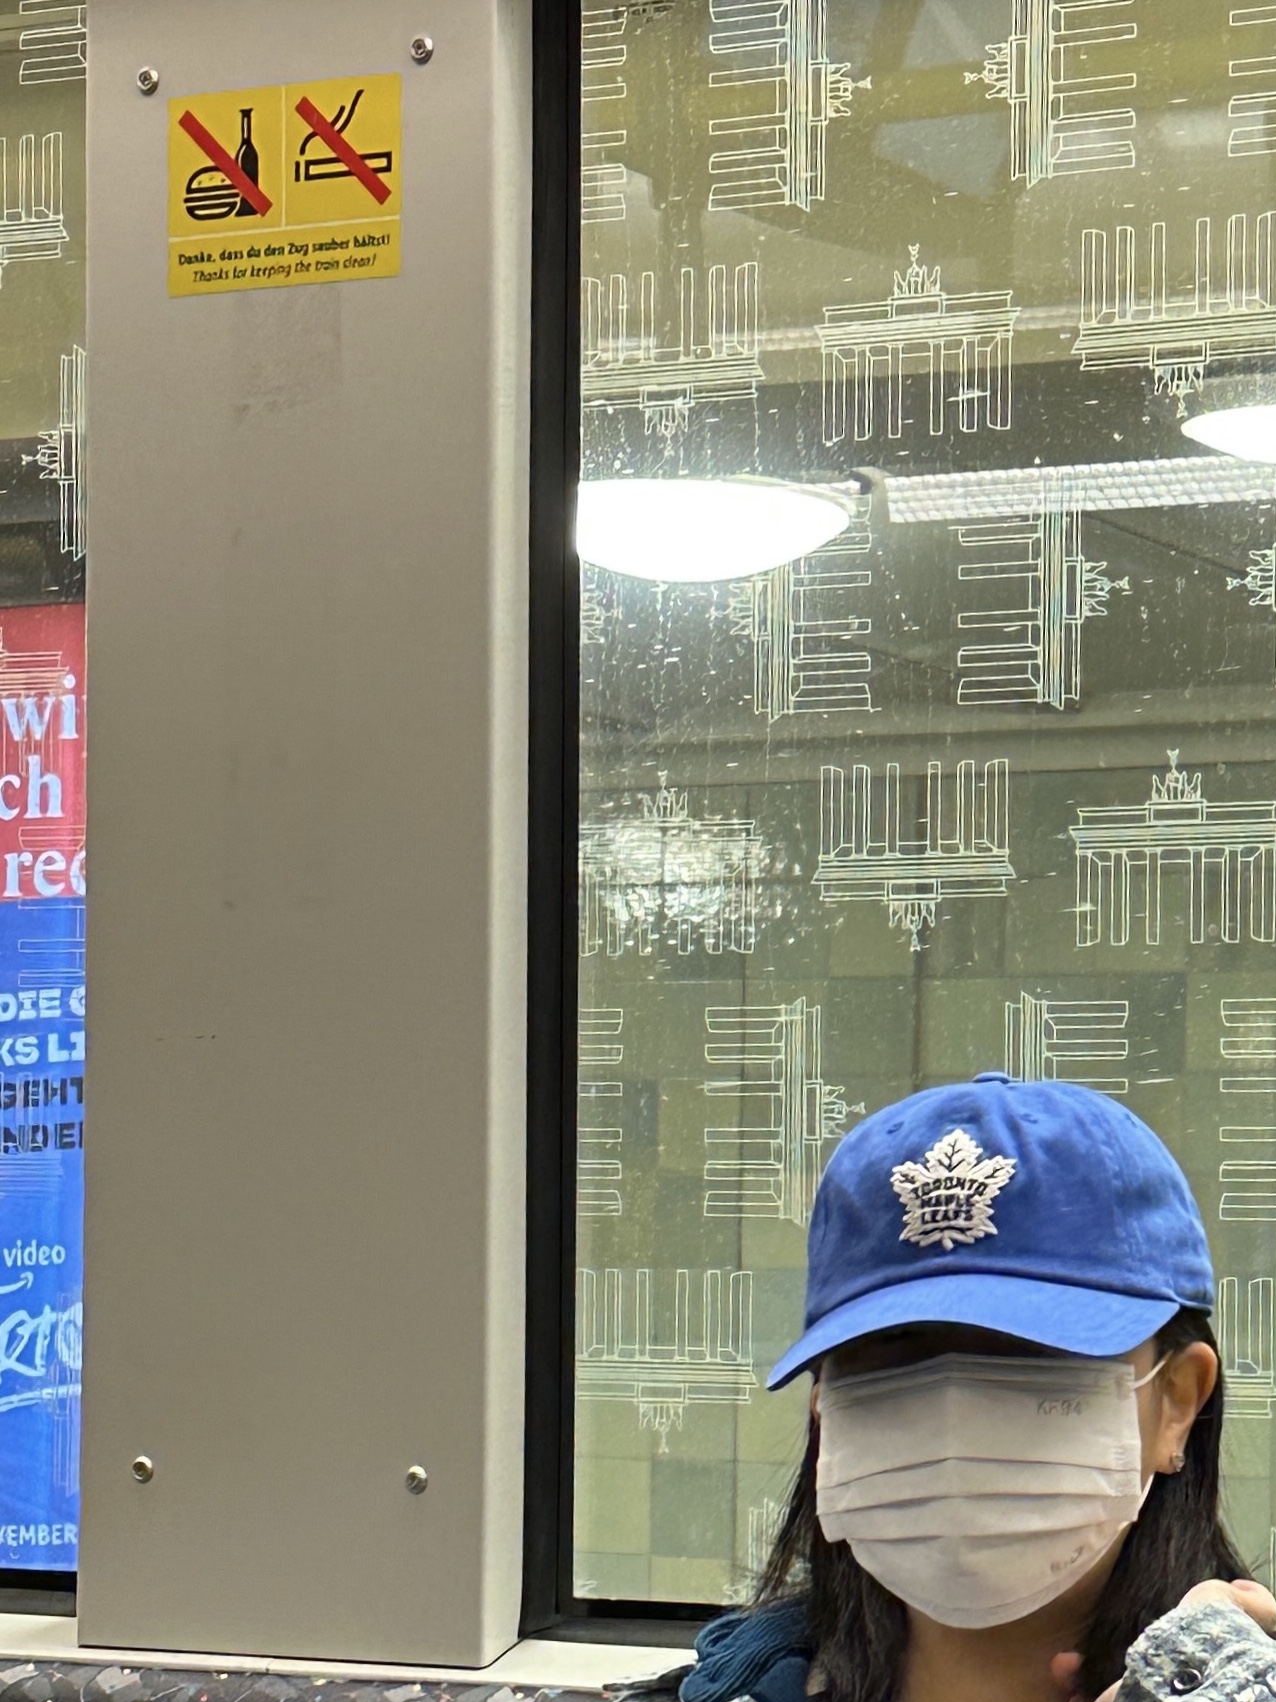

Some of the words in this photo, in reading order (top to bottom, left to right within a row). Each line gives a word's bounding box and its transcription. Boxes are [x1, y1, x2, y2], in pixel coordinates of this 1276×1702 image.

[219, 249, 244, 261] dass
[246, 245, 260, 258] du
[264, 244, 285, 257] den
[288, 243, 309, 256] Zug
[312, 237, 350, 253] sauber
[193, 268, 229, 282] Thanks
[232, 265, 248, 279] for
[250, 263, 291, 279] keeping
[294, 260, 312, 273] the
[315, 259, 340, 271] train
[343, 253, 376, 269] clean!
[910, 1176, 988, 1199] TORONTO
[921, 1193, 975, 1209] MAPLE
[921, 1208, 974, 1224] LEAFS
[3, 1239, 66, 1267] video
